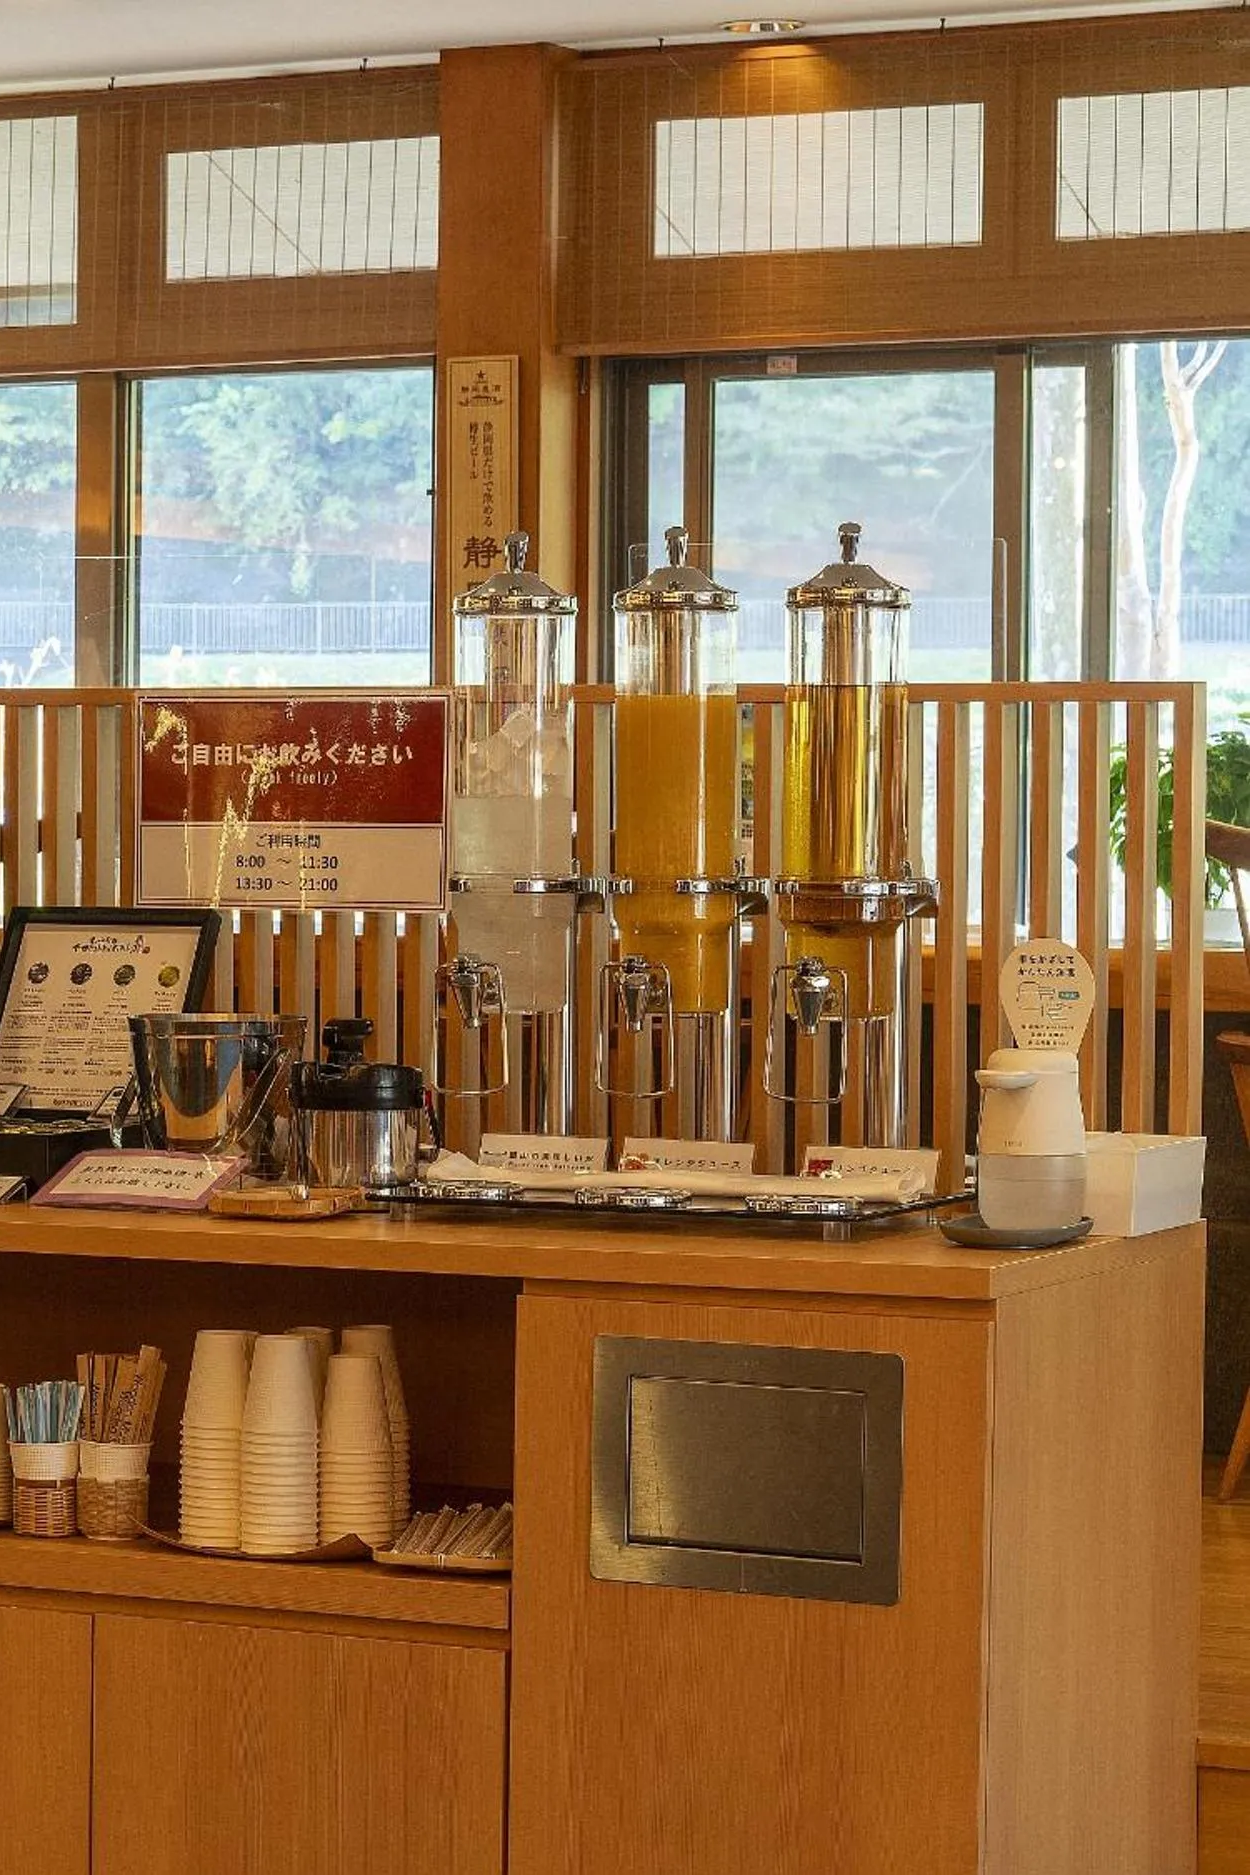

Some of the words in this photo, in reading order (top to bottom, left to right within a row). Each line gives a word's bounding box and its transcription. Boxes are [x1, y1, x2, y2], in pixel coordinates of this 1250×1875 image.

[171, 743, 414, 767] ご自由にお飲みください
[256, 834, 321, 849] ご利用時間
[236, 855, 266, 868] 8:00
[302, 856, 338, 869] 11:30
[236, 877, 273, 890] 13:30
[299, 878, 338, 891] 21:00
